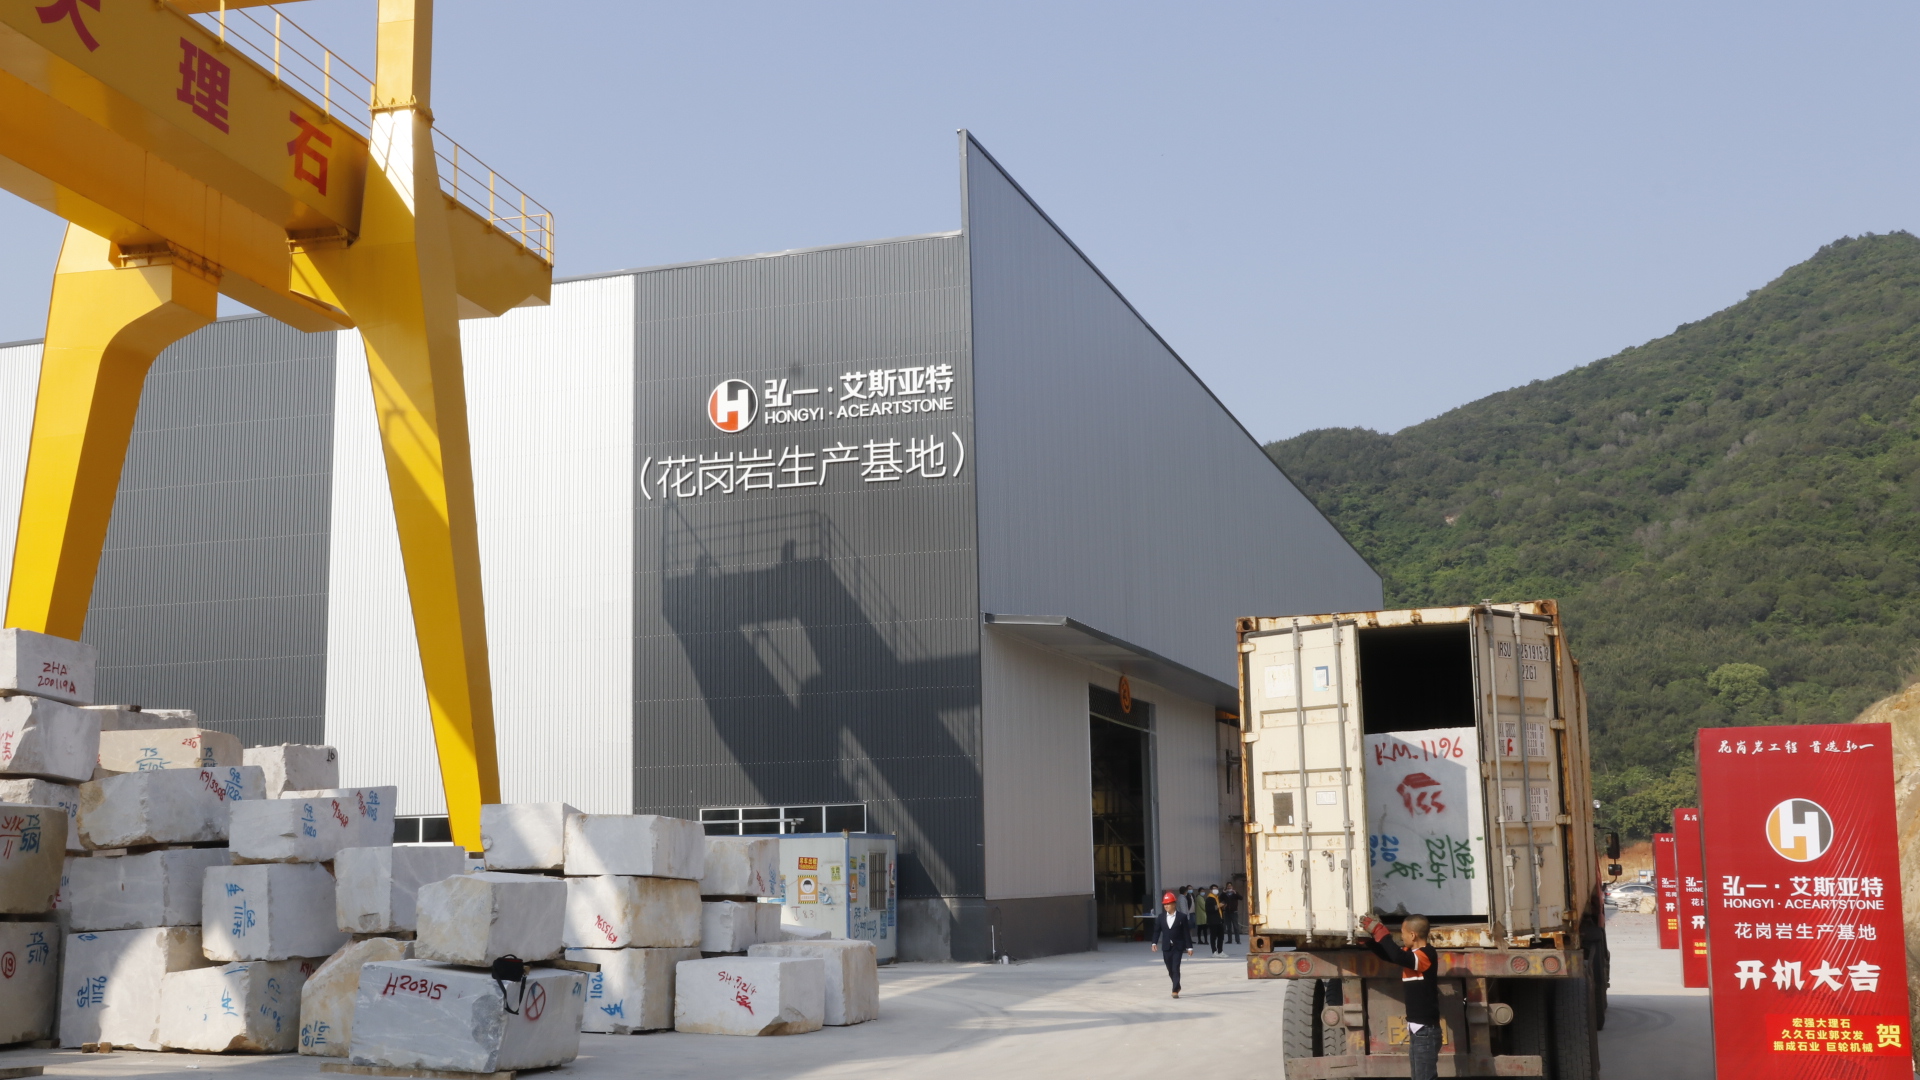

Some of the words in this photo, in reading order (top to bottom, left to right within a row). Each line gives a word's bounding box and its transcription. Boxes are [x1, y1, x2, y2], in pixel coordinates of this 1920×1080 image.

[765, 407, 824, 424] HONGYI
[836, 397, 954, 419] ACEARTSTONE
[1723, 898, 1774, 909] HONGYI
[1785, 898, 1885, 911] ACEARTSTONE
[1734, 922, 1877, 941] 花岗岩生产基地
[1734, 958, 1882, 993] 开机大吉
[1792, 1017, 1851, 1029] 宏强大理石
[1781, 1029, 1864, 1041] 久久石业郭文发
[1876, 1023, 1902, 1048] 贺
[1773, 1041, 1820, 1052] 振成石业
[1826, 1042, 1874, 1053] 巨轮机械
